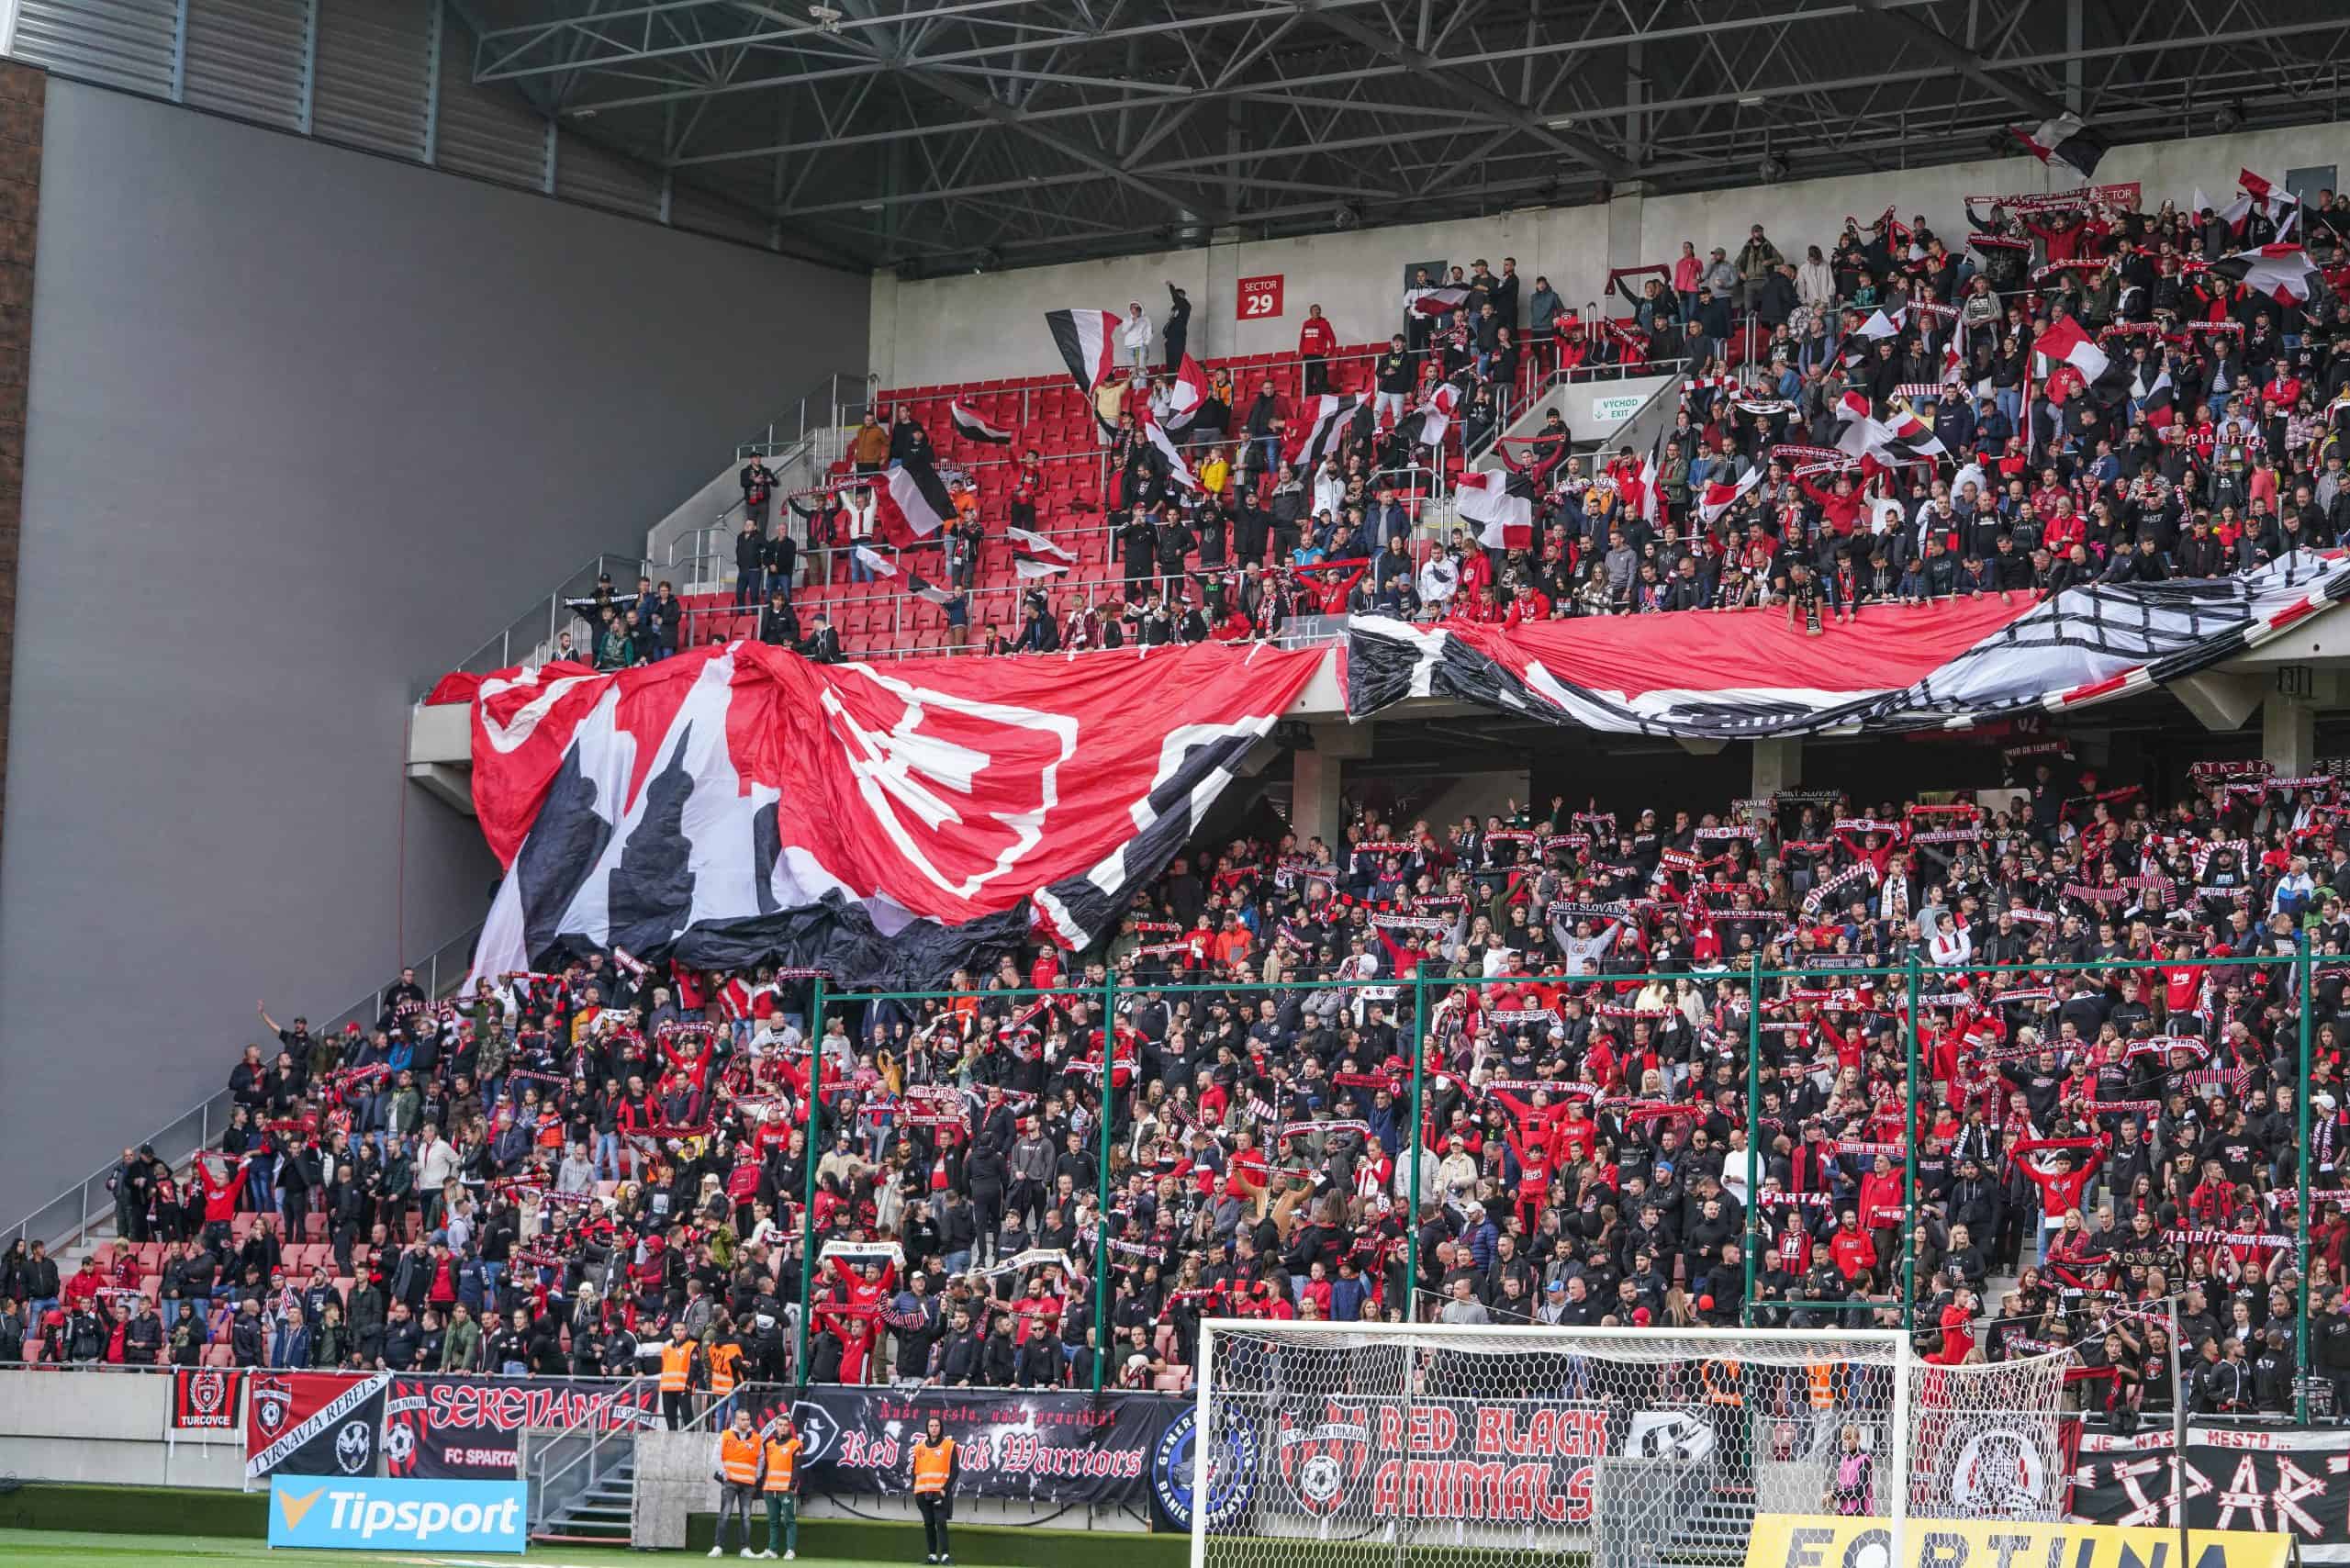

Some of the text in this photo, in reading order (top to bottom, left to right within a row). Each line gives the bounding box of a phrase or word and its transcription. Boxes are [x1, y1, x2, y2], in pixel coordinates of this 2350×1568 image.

[2095, 189, 2132, 202] SETOR
[1244, 280, 1277, 292] SECTOR
[1247, 295, 1273, 315] 29
[1611, 409, 1629, 418] EXIT
[1551, 902, 1578, 913] SMRT
[181, 1416, 232, 1426] TURCOVCE
[252, 1376, 380, 1474] TYRNAVIA REBELS
[1380, 1406, 1610, 1457] RED BLACK
[2091, 1435, 2113, 1450] JE
[444, 1448, 464, 1464] FC
[838, 1429, 898, 1470] Red
[1001, 1432, 1144, 1479] Warriors
[1372, 1460, 1595, 1521] ANIMALS
[2113, 1453, 2350, 1539] SPAR
[329, 1492, 520, 1540] Tipsport
